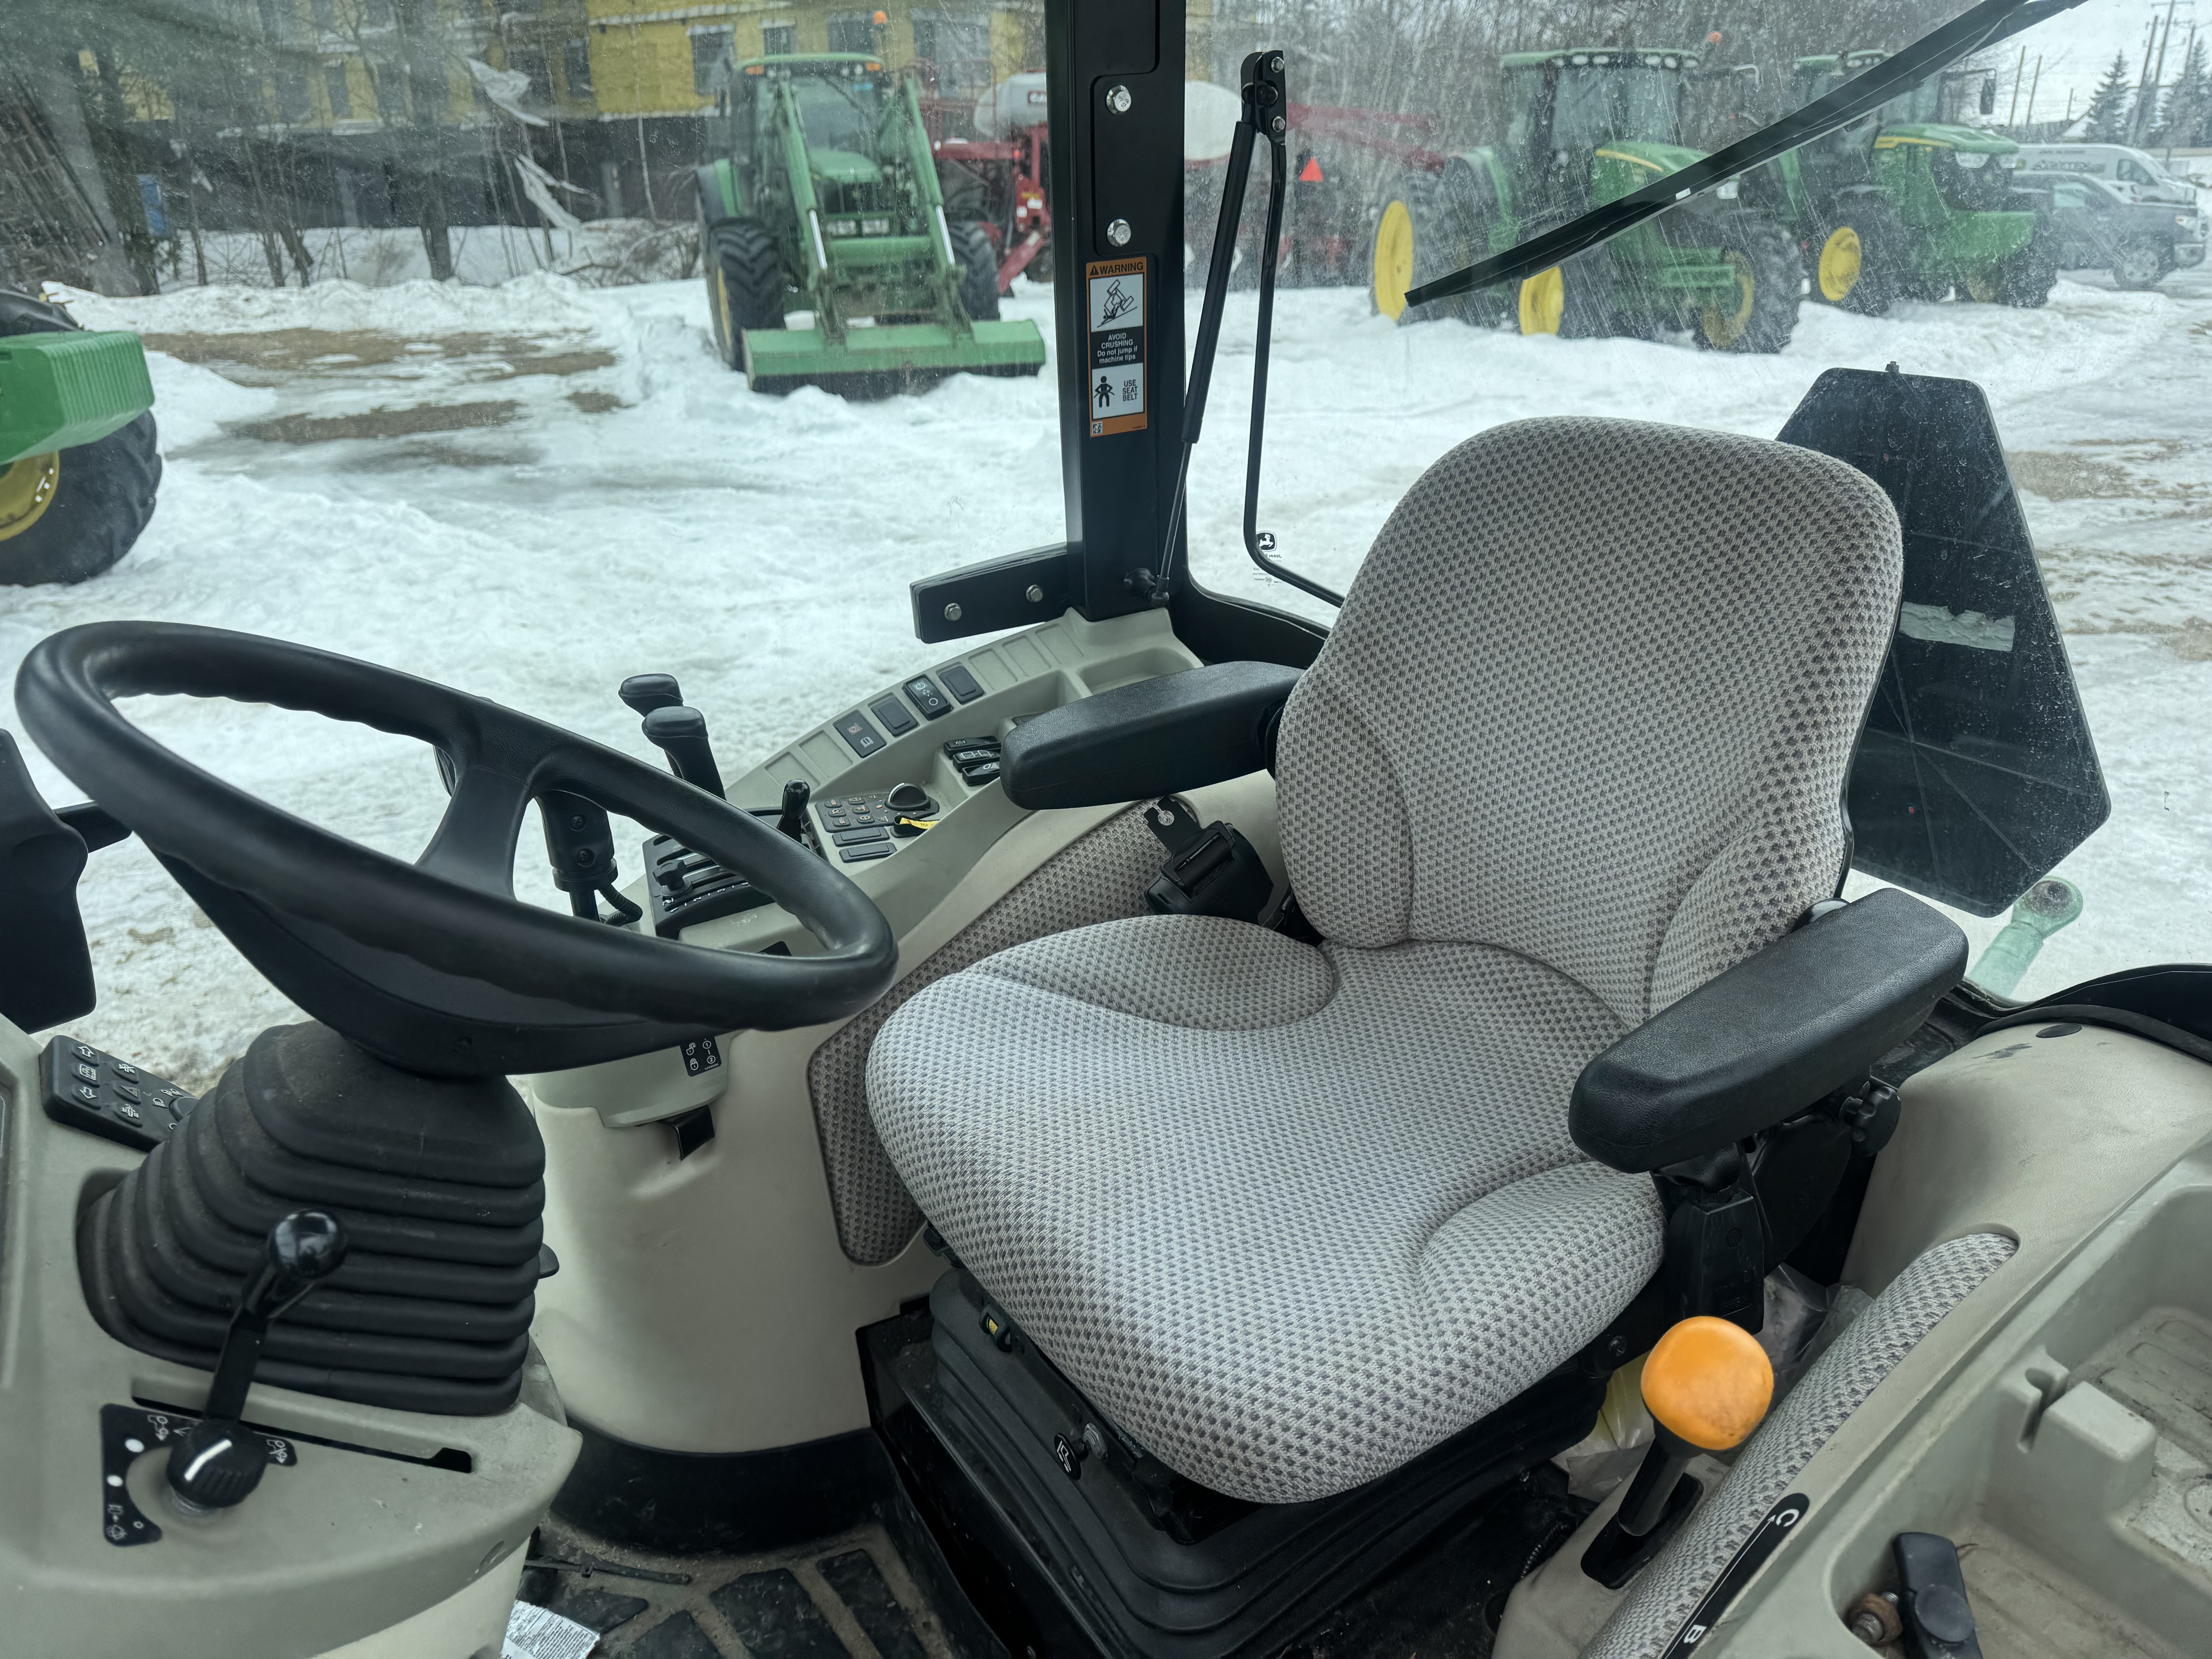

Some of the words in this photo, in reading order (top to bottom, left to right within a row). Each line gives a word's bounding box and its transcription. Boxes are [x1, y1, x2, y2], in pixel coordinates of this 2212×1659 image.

[1100, 262, 1143, 275] WARNING
[1108, 333, 1126, 341] AVOID
[1101, 339, 1133, 349] CRUSHING
[1099, 356, 1123, 364] machine
[1124, 379, 1136, 387] USE
[1123, 386, 1138, 395] SEAT
[1123, 393, 1138, 401] BELT
[1776, 1509, 1799, 1527] C
[1683, 1625, 1707, 1644] B
